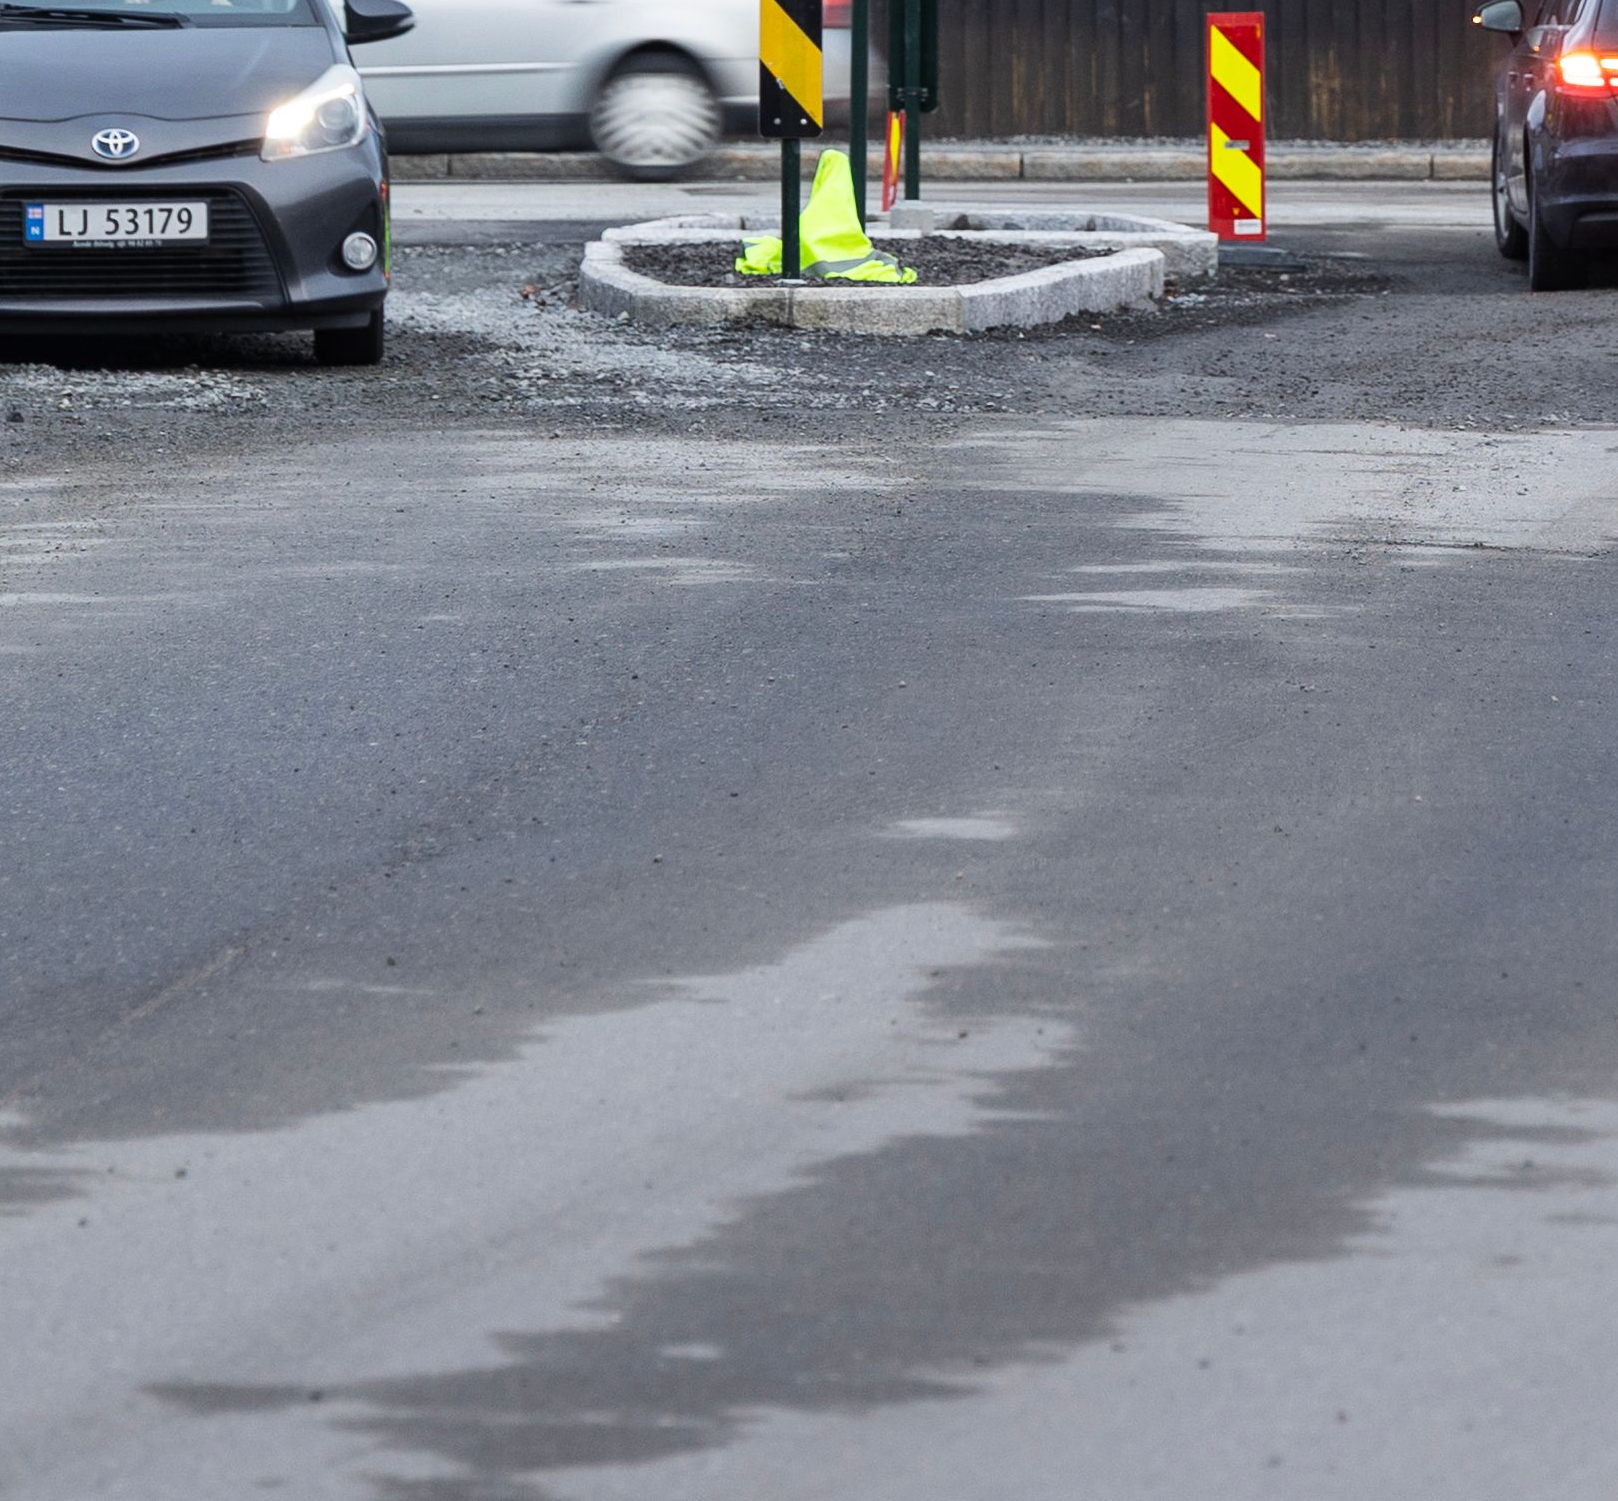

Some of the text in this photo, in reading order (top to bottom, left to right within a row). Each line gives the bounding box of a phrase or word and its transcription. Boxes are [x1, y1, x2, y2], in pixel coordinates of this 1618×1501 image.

[30, 226, 40, 236] N
[58, 207, 193, 236] LJ 53179
